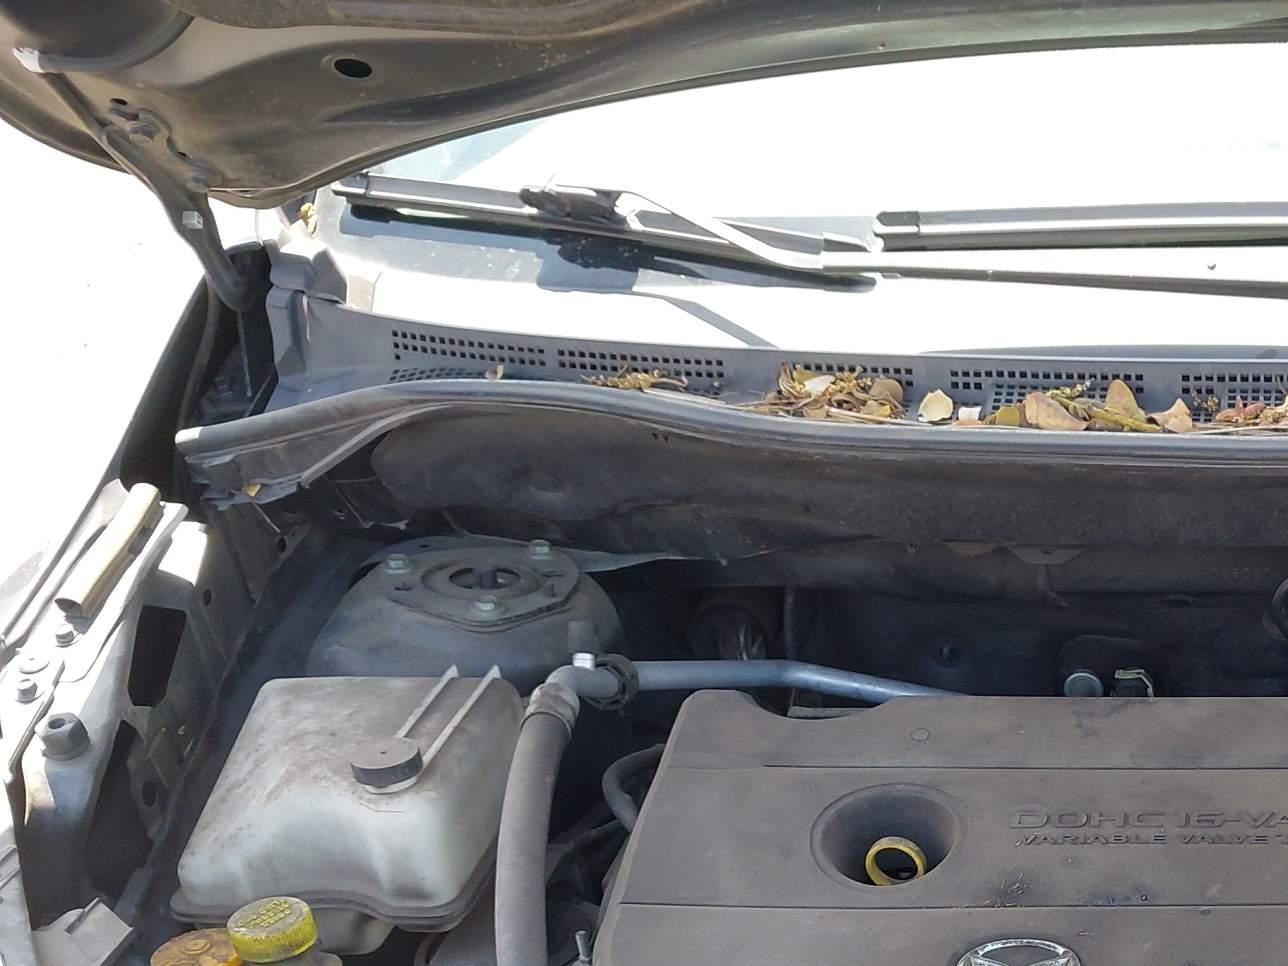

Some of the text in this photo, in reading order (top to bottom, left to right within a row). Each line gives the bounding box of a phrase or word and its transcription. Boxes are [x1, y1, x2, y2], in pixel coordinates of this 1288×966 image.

[1009, 810, 1166, 829] DOHC
[1018, 832, 1168, 846] VARIABLE
[1177, 833, 1269, 845] VALVE
